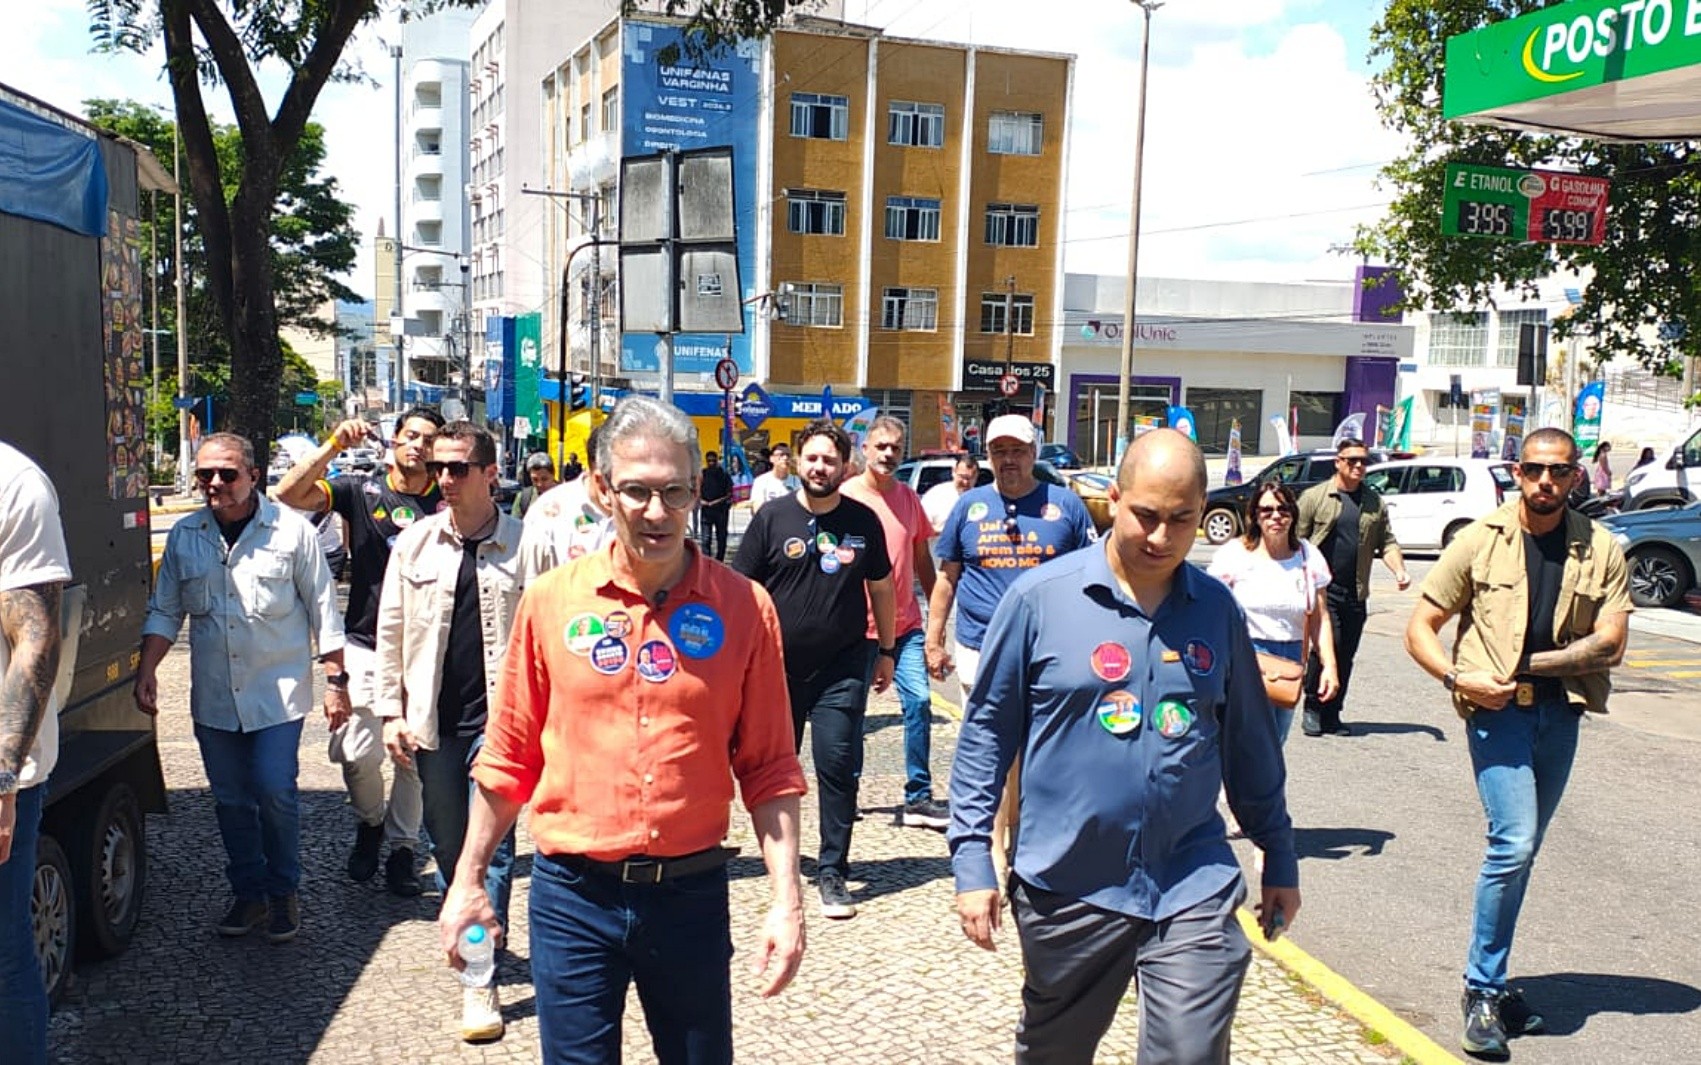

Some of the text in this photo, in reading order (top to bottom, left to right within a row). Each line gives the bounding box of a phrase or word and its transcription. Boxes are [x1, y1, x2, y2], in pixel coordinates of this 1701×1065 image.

[1542, 0, 1673, 71] POSTO
[662, 77, 729, 93] VARGINHA
[657, 95, 698, 108] VEST
[1453, 171, 1514, 194] E ETANOL
[1550, 176, 1560, 192] G
[1104, 322, 1177, 341] OrlUnic
[674, 346, 729, 359] UNIFENAS
[968, 363, 1004, 377] Casa
[1033, 366, 1051, 378] 25
[791, 402, 862, 414] MERADO
